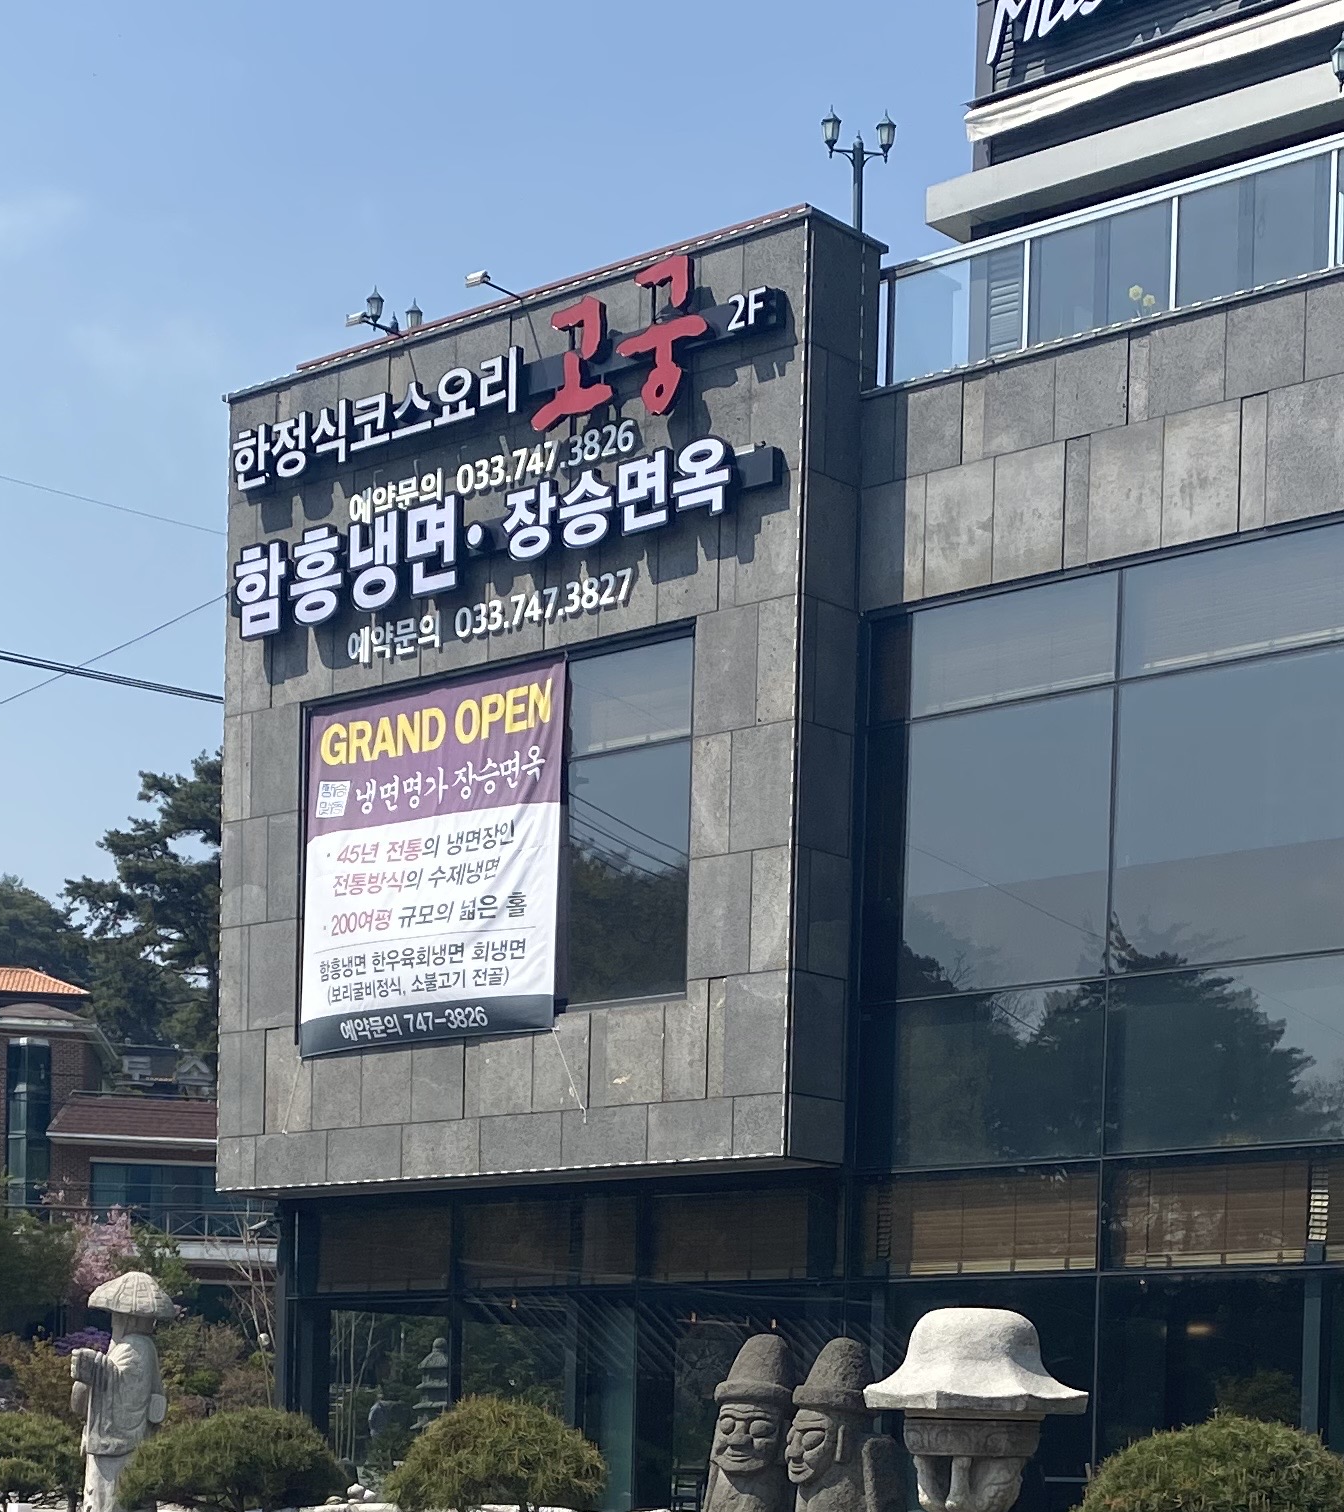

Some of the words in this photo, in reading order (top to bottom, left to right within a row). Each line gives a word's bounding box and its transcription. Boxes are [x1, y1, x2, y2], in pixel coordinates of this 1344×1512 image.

[233, 347, 519, 492] 한정식코스요리
[531, 254, 708, 431] 고궁
[727, 286, 769, 332] 2F
[349, 467, 443, 524] 예약문의
[456, 419, 636, 495] 033.747.3826
[504, 437, 733, 561] 장승면옥
[348, 610, 440, 664] 예약문의
[455, 567, 633, 638] 033.747.3827
[320, 707, 447, 766] GRAND
[454, 678, 552, 745] OPEN
[356, 766, 448, 815] 냉면명가
[452, 745, 546, 800] 장승면옥
[337, 841, 380, 864] 45년
[386, 834, 441, 863] 전통의
[447, 819, 515, 856] 냉면장인
[333, 868, 424, 898] 전통방식의
[428, 857, 501, 888] 수제냉면
[331, 908, 393, 937] 200여평
[398, 901, 455, 929] 규모의
[459, 894, 498, 921] 넓은
[506, 891, 528, 918] 홀
[319, 954, 367, 983] 함흥냉면
[371, 942, 465, 973] 한우육회냉면
[471, 937, 527, 962] 회냉면
[411, 968, 466, 993] 소불고기
[472, 965, 510, 987] 전골)
[340, 1013, 403, 1042] 예약문의
[403, 1006, 489, 1034] 747-3826
